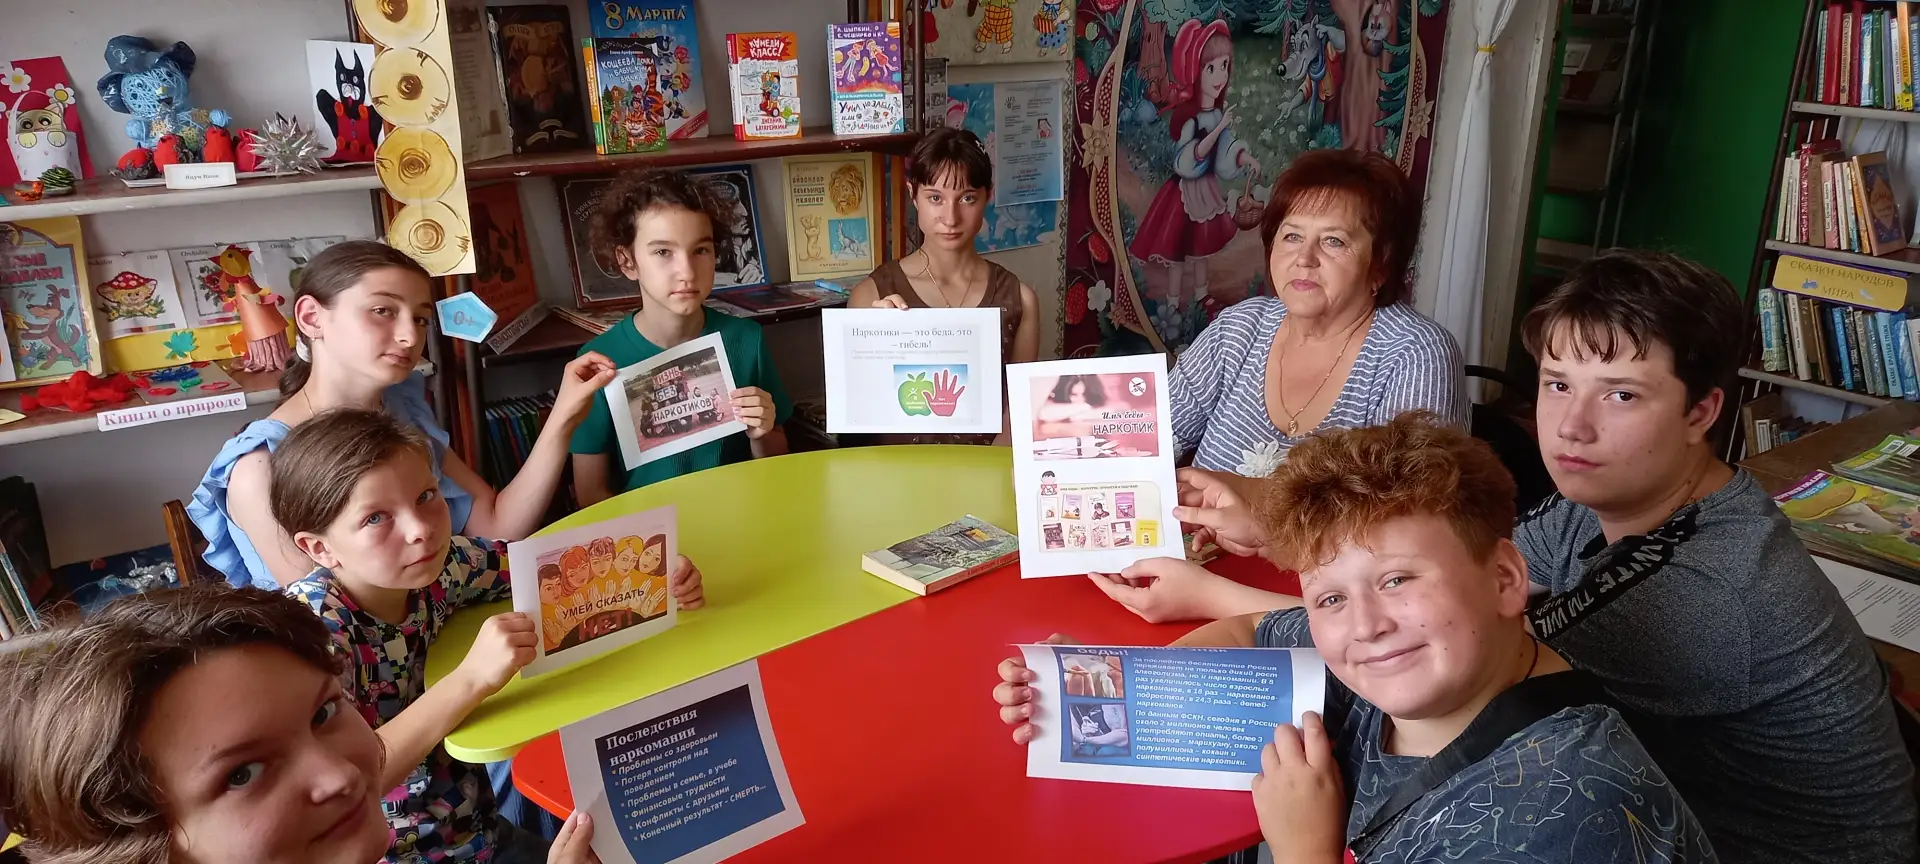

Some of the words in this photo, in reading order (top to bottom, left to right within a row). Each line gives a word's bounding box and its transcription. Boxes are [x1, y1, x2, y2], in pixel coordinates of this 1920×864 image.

[604, 2, 624, 30] 8
[600, 57, 635, 70] КОЩЕЕВА
[1790, 260, 1836, 277] СКАЗКИ
[1838, 268, 1895, 288] НАРОДОВ
[1822, 286, 1855, 300] МИРА
[852, 328, 900, 338] Наркотики
[932, 327, 954, 338] беда,
[957, 328, 972, 336] это
[900, 340, 932, 350] гибель!
[656, 387, 676, 400] БЕЗ
[104, 408, 157, 426] Книги
[162, 408, 171, 417] о
[176, 397, 242, 416] природе
[654, 398, 712, 421] НАРКОТИКОВ
[1093, 422, 1154, 434] НАРКОТИК
[562, 600, 593, 620] УМЕЙ
[596, 588, 645, 609] СКАЗАТЬ
[578, 607, 633, 642] НЕТ!
[1134, 663, 1183, 672] переживает
[1134, 669, 1187, 678] алкоголизма,
[1208, 675, 1260, 684] наркомании.
[1136, 676, 1148, 684] раз
[1150, 677, 1201, 688] увеличилось
[1229, 684, 1270, 692] взрослых
[1136, 684, 1186, 694] наркоманов,
[1136, 692, 1187, 702] подростков,
[1195, 696, 1212, 704] 24,3
[1136, 700, 1184, 709] наркоманов.
[1148, 710, 1179, 719] данным
[1180, 713, 1206, 721] ФСКН,
[1207, 716, 1240, 724] сегодня
[606, 709, 698, 750] Последствия
[1166, 722, 1211, 730] миллионов
[1136, 727, 1194, 736] употребляют
[1196, 731, 1230, 740] опиаты,
[1232, 734, 1256, 742] более
[609, 726, 696, 767] наркомании
[1136, 736, 1180, 744] миллионов
[1188, 739, 1232, 749] марихуану,
[1234, 742, 1258, 750] около
[1136, 744, 1194, 754] полумиллиона
[622, 770, 652, 786] Потеря
[654, 754, 692, 774] контроля
[694, 748, 708, 759] над
[1136, 754, 1200, 764] синтетические
[1200, 757, 1247, 766] наркотики.
[624, 772, 675, 796] поведением
[628, 785, 672, 808] Проблемы
[680, 772, 706, 786] семье,
[714, 758, 738, 774] учебе
[631, 793, 684, 818] Финансовые
[684, 775, 726, 796] трудности
[636, 805, 684, 830] Конфликты
[692, 786, 730, 808] друзьями
[640, 818, 682, 841] Конечный
[684, 800, 723, 824] результат
